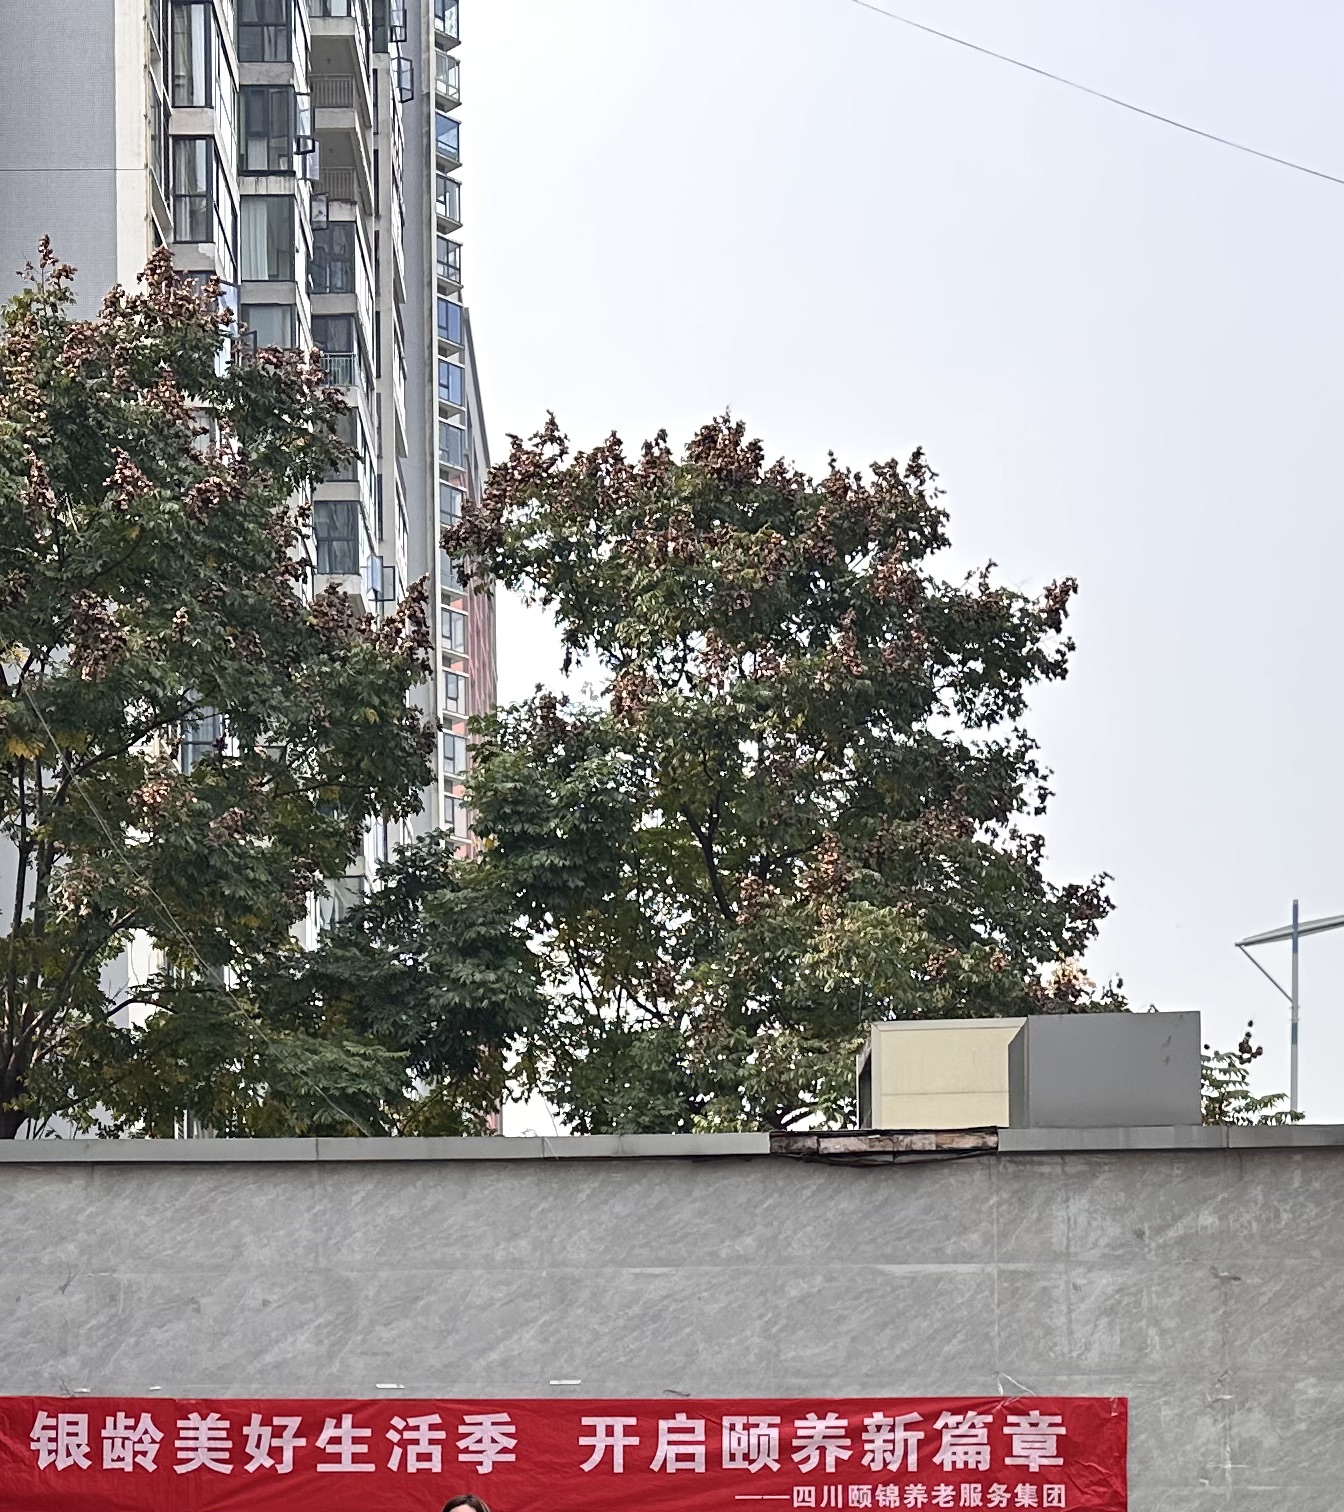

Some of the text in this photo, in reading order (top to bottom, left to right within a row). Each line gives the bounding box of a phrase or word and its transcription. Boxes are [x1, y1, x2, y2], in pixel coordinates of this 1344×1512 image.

[30, 1410, 1067, 1474] 银龄美好生活季 开启颐养新篇章
